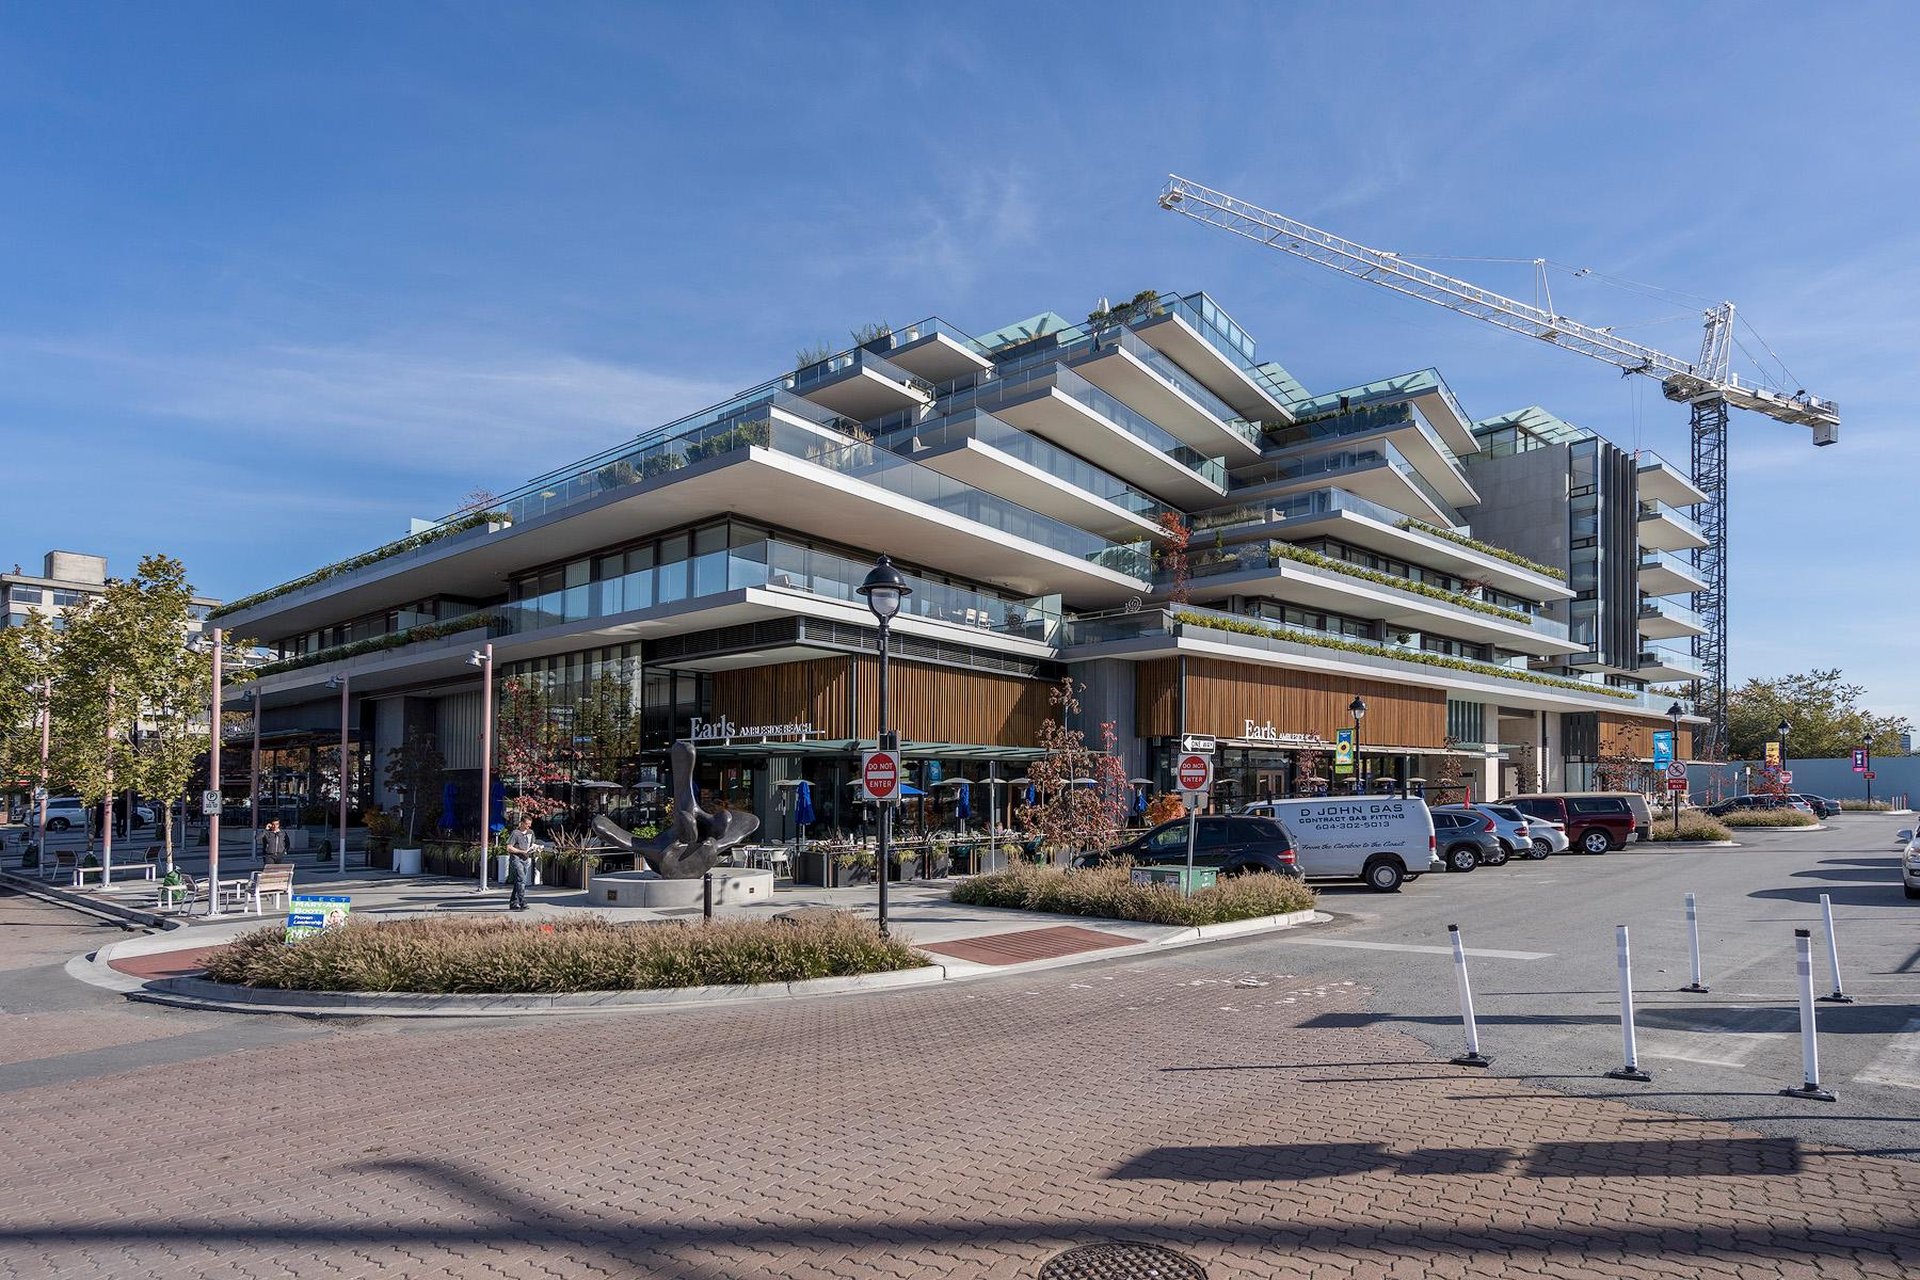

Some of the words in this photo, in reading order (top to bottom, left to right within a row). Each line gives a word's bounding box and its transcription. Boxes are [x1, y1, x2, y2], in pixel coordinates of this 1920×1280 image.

[690, 714, 735, 739] Earls
[740, 724, 782, 736] AMBLESIDE
[784, 721, 812, 733] BEACH
[1245, 719, 1277, 739] Earls
[870, 780, 892, 788] ENTER
[1300, 808, 1311, 817] D
[1317, 806, 1363, 816] JOHN
[1370, 804, 1403, 814] GAS
[1299, 816, 1346, 824] CONTRACT
[1315, 821, 1390, 830] 604-302-5013
